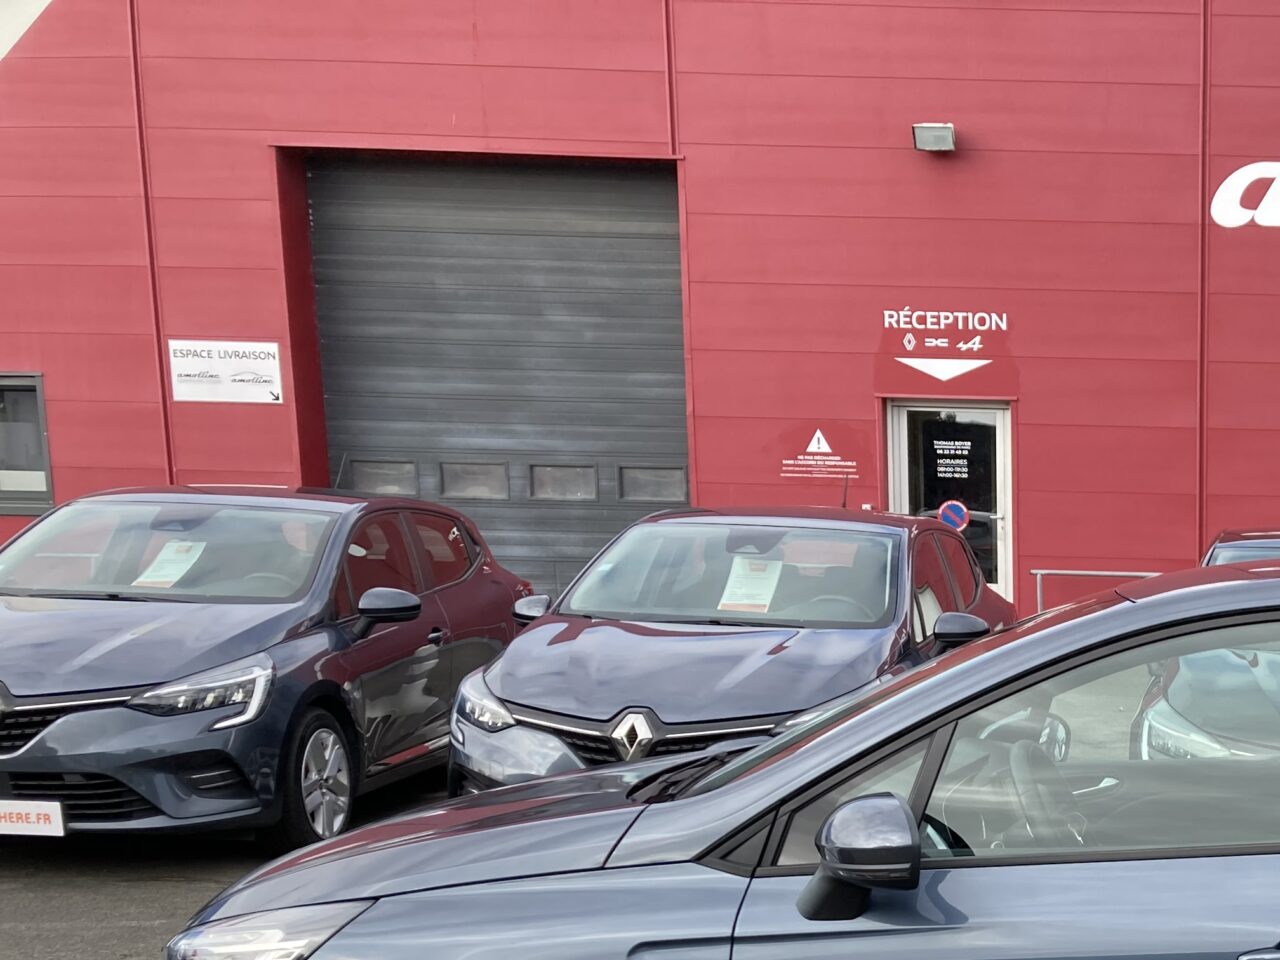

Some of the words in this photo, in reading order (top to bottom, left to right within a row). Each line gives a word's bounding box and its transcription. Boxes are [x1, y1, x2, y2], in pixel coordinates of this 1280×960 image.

[883, 306, 1008, 331] RÉCEPTION
[173, 349, 213, 358] ESPACE
[218, 351, 276, 360] LIVRAISON
